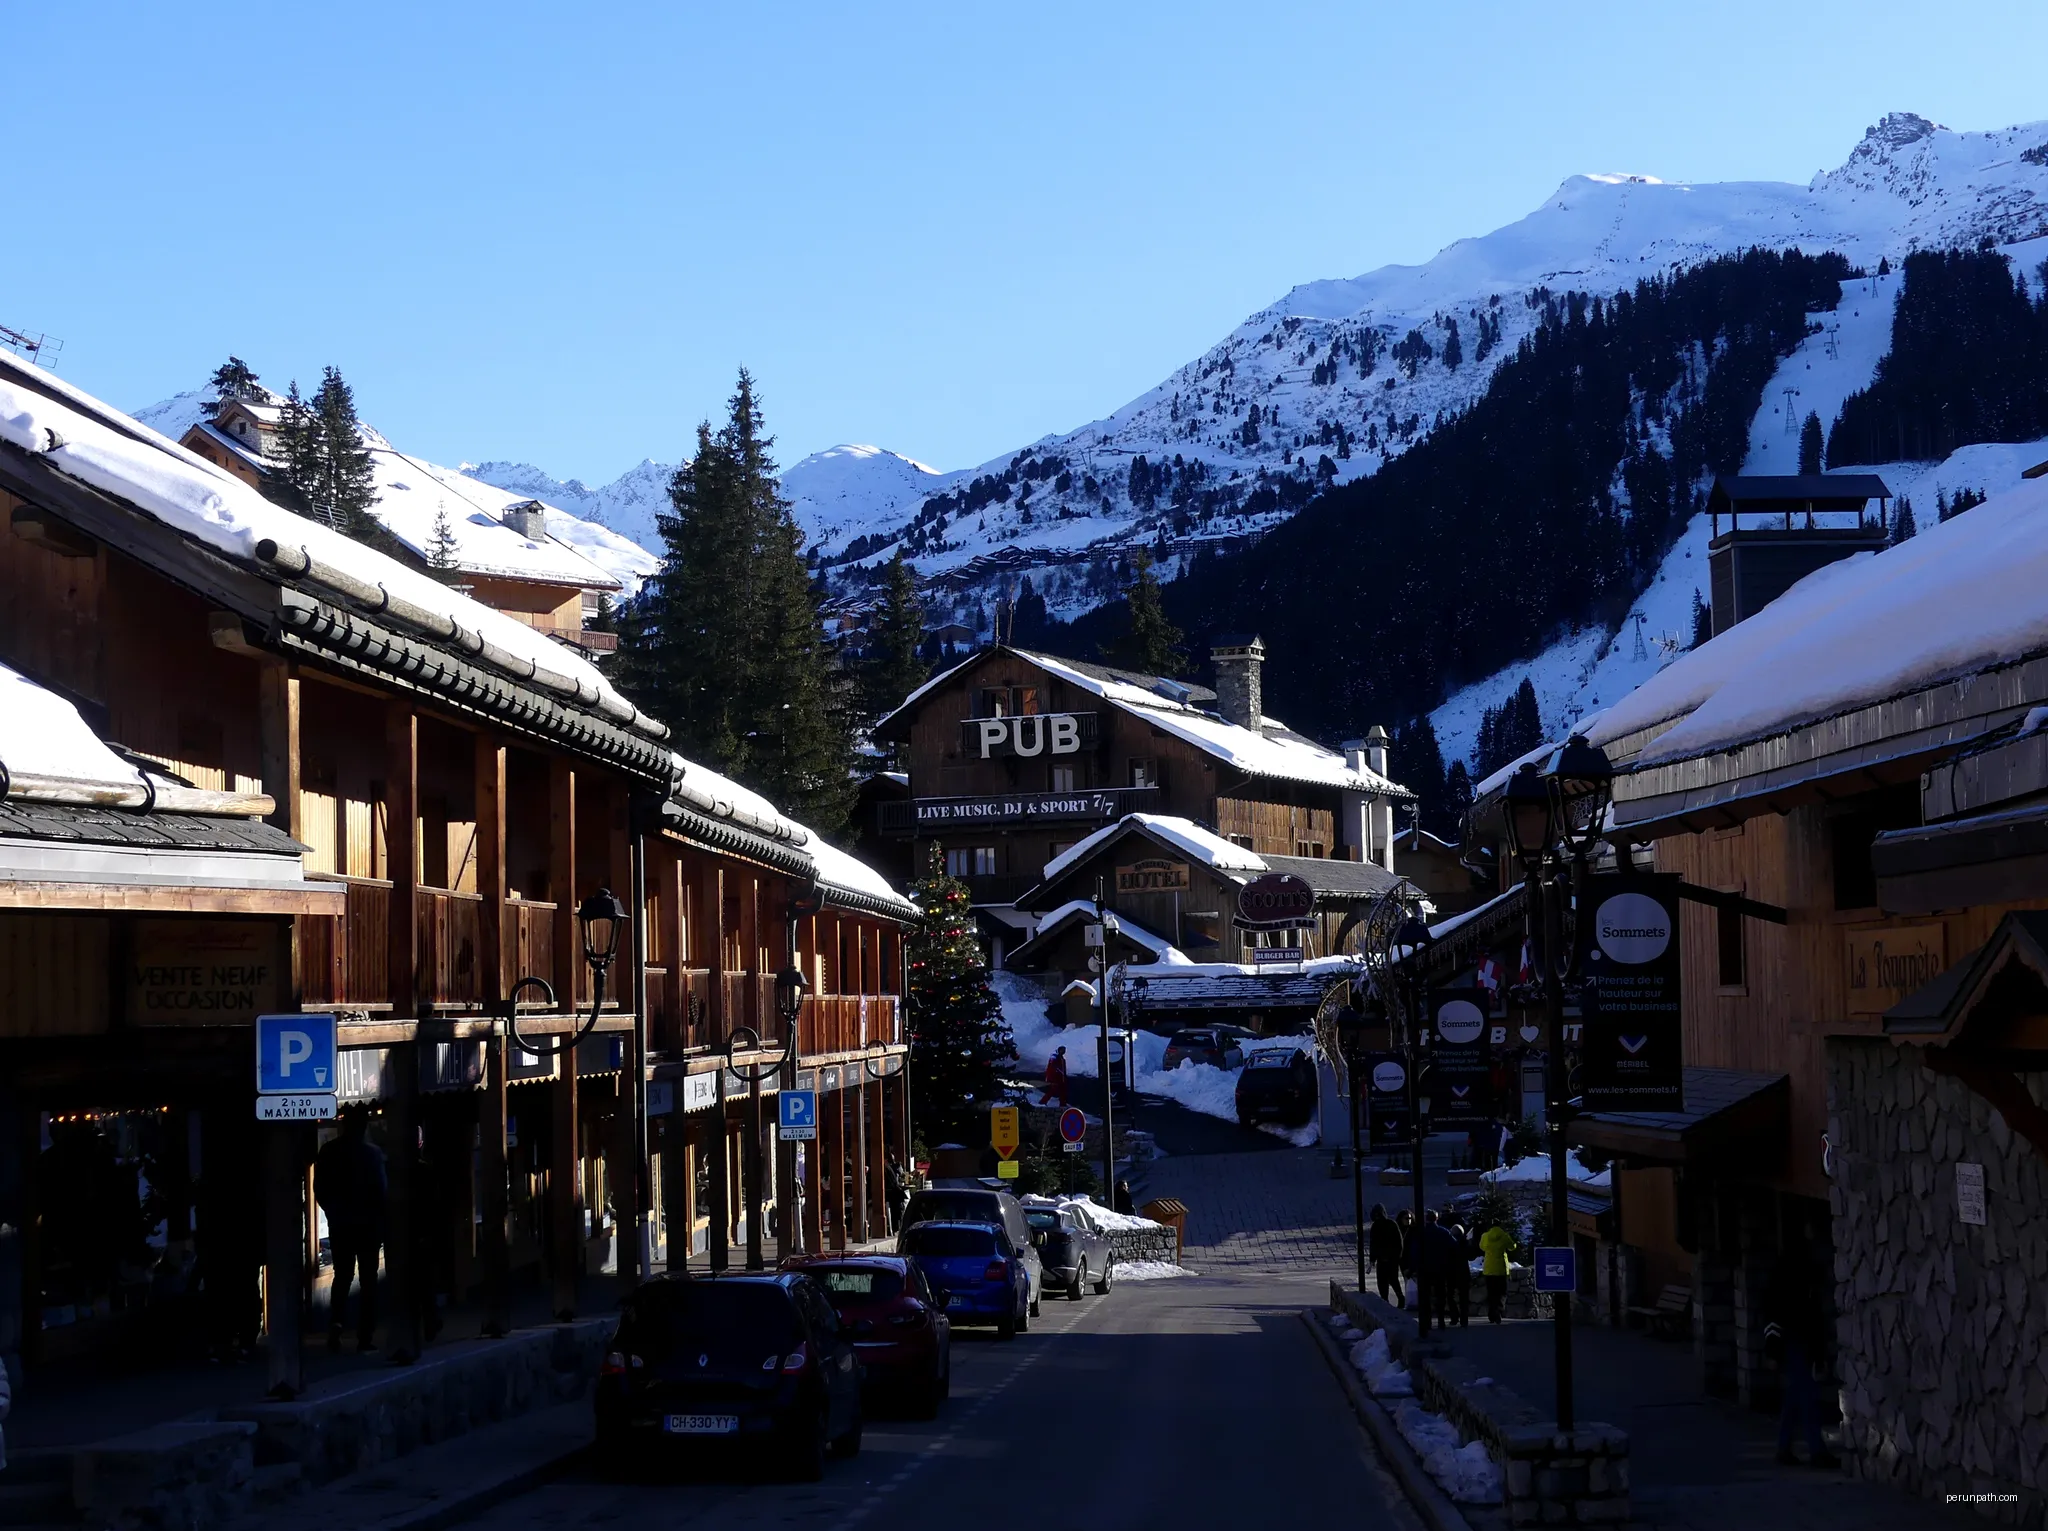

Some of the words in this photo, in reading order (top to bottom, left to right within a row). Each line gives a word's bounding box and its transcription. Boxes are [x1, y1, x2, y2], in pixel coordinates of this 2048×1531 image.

[979, 716, 1081, 759] PUB
[917, 806, 950, 819] LIVE
[953, 803, 1000, 817] MUSIC,
[1004, 803, 1022, 815] DJ
[1026, 801, 1037, 814] &
[1040, 800, 1088, 813] SPORT
[1093, 794, 1114, 816] 7/7
[1120, 870, 1186, 890] HOTEL
[1602, 926, 1666, 938] Sommets
[1256, 951, 1284, 960] BURGER
[1285, 951, 1300, 960] BAR
[1850, 943, 1867, 988] La
[134, 966, 203, 986] VENTE
[211, 966, 267, 986] NEUF
[1598, 975, 1635, 985] Prenez
[1637, 975, 1651, 985] de
[1653, 974, 1664, 985] la
[145, 990, 254, 1010] OCCASION
[1598, 989, 1643, 998] hauteur
[1598, 1002, 1628, 1011] votre
[1629, 1001, 1678, 1011] business
[1441, 1020, 1480, 1028] Sommets
[280, 1031, 313, 1077] P
[1588, 1086, 1678, 1095] www.les-sommets.fr
[265, 1108, 329, 1118] MAXIMUM
[789, 1097, 805, 1120] P
